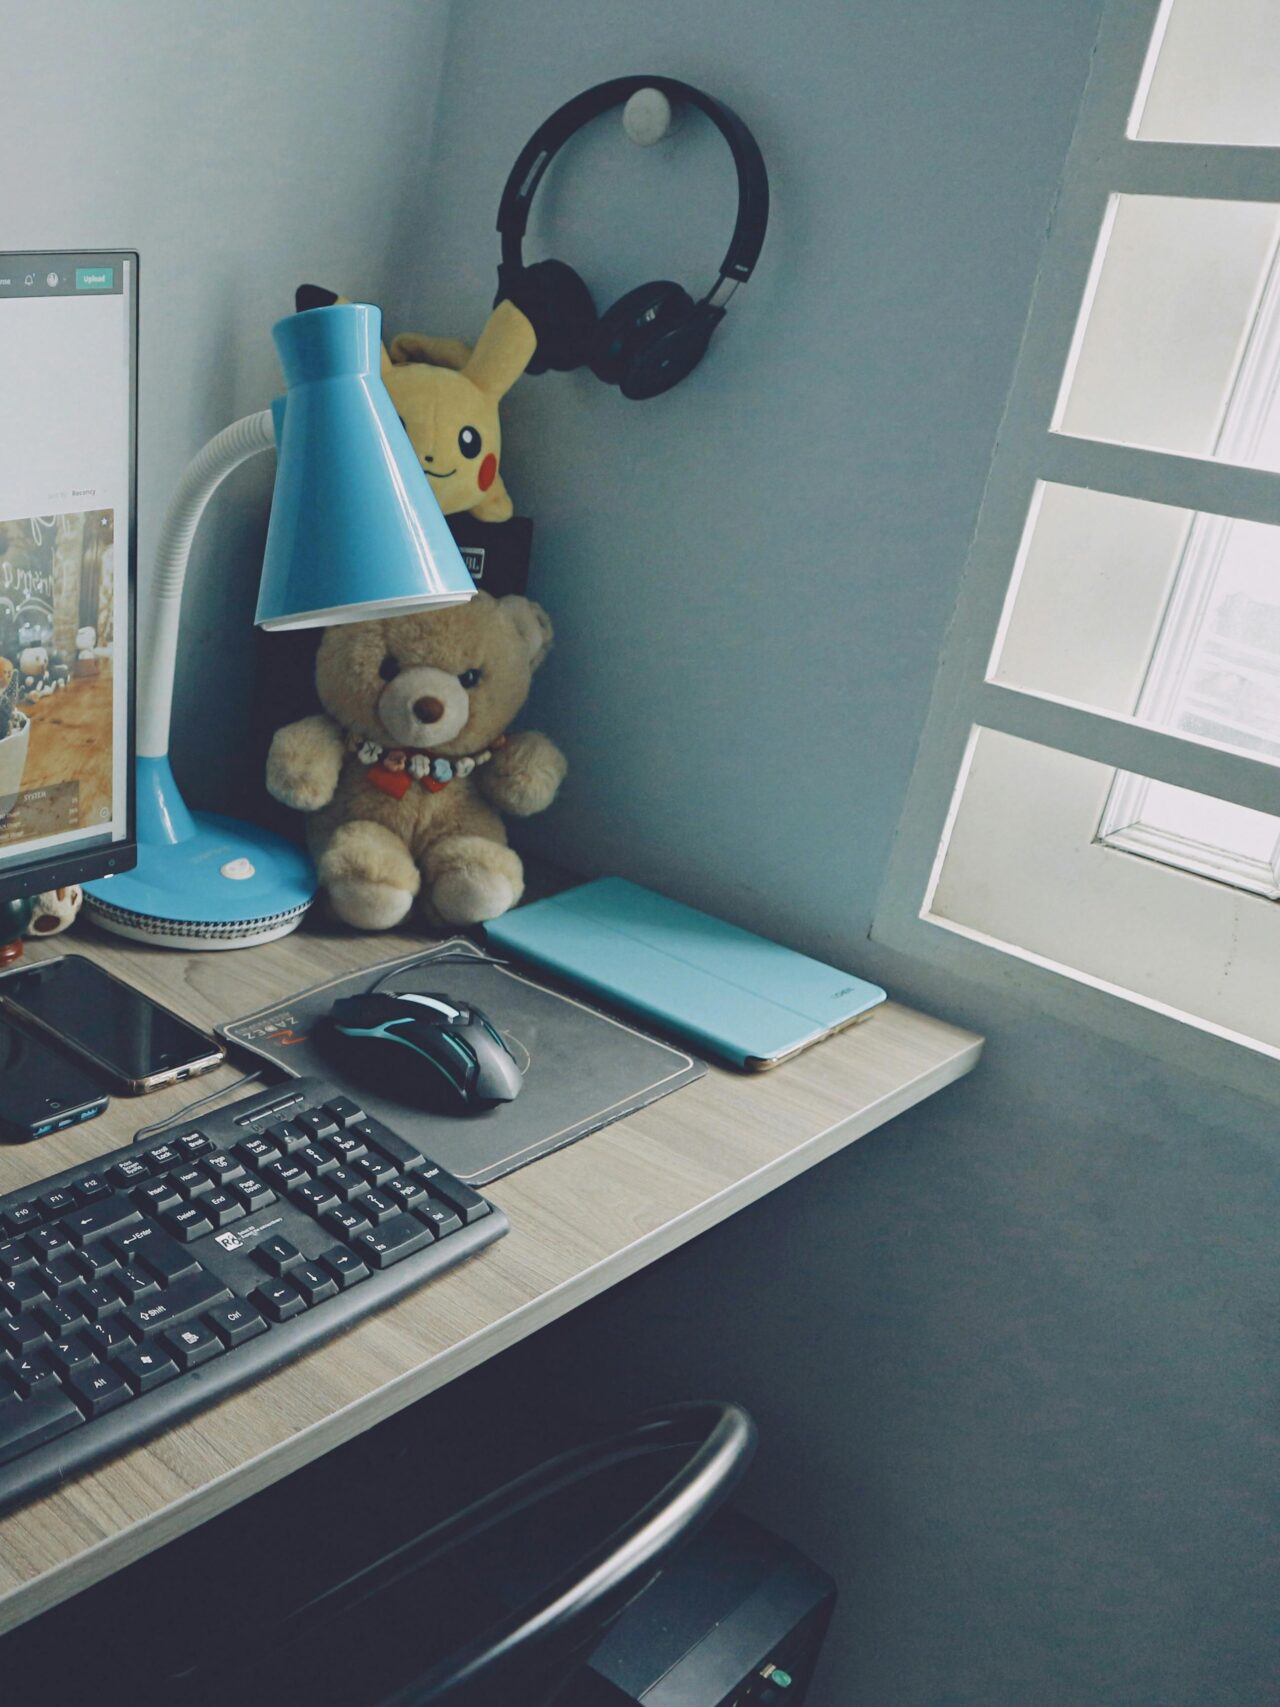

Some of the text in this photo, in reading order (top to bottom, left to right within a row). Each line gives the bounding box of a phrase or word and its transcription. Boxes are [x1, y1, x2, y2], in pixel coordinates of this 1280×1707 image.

[84, 274, 105, 284] Upload
[156, 1150, 172, 1160] Lock
[209, 1156, 226, 1166] Page
[180, 1171, 198, 1182] Home
[282, 1167, 298, 1178] Home
[424, 1167, 439, 1178] Enter
[239, 1179, 255, 1190] Page
[245, 1183, 262, 1193] Down
[148, 1185, 167, 1196] Insert
[176, 1209, 196, 1221] Delete
[137, 1228, 152, 1239] Enter
[149, 1305, 166, 1318] Shift
[227, 1310, 242, 1321] Ctrl
[93, 1378, 107, 1389] Alt
